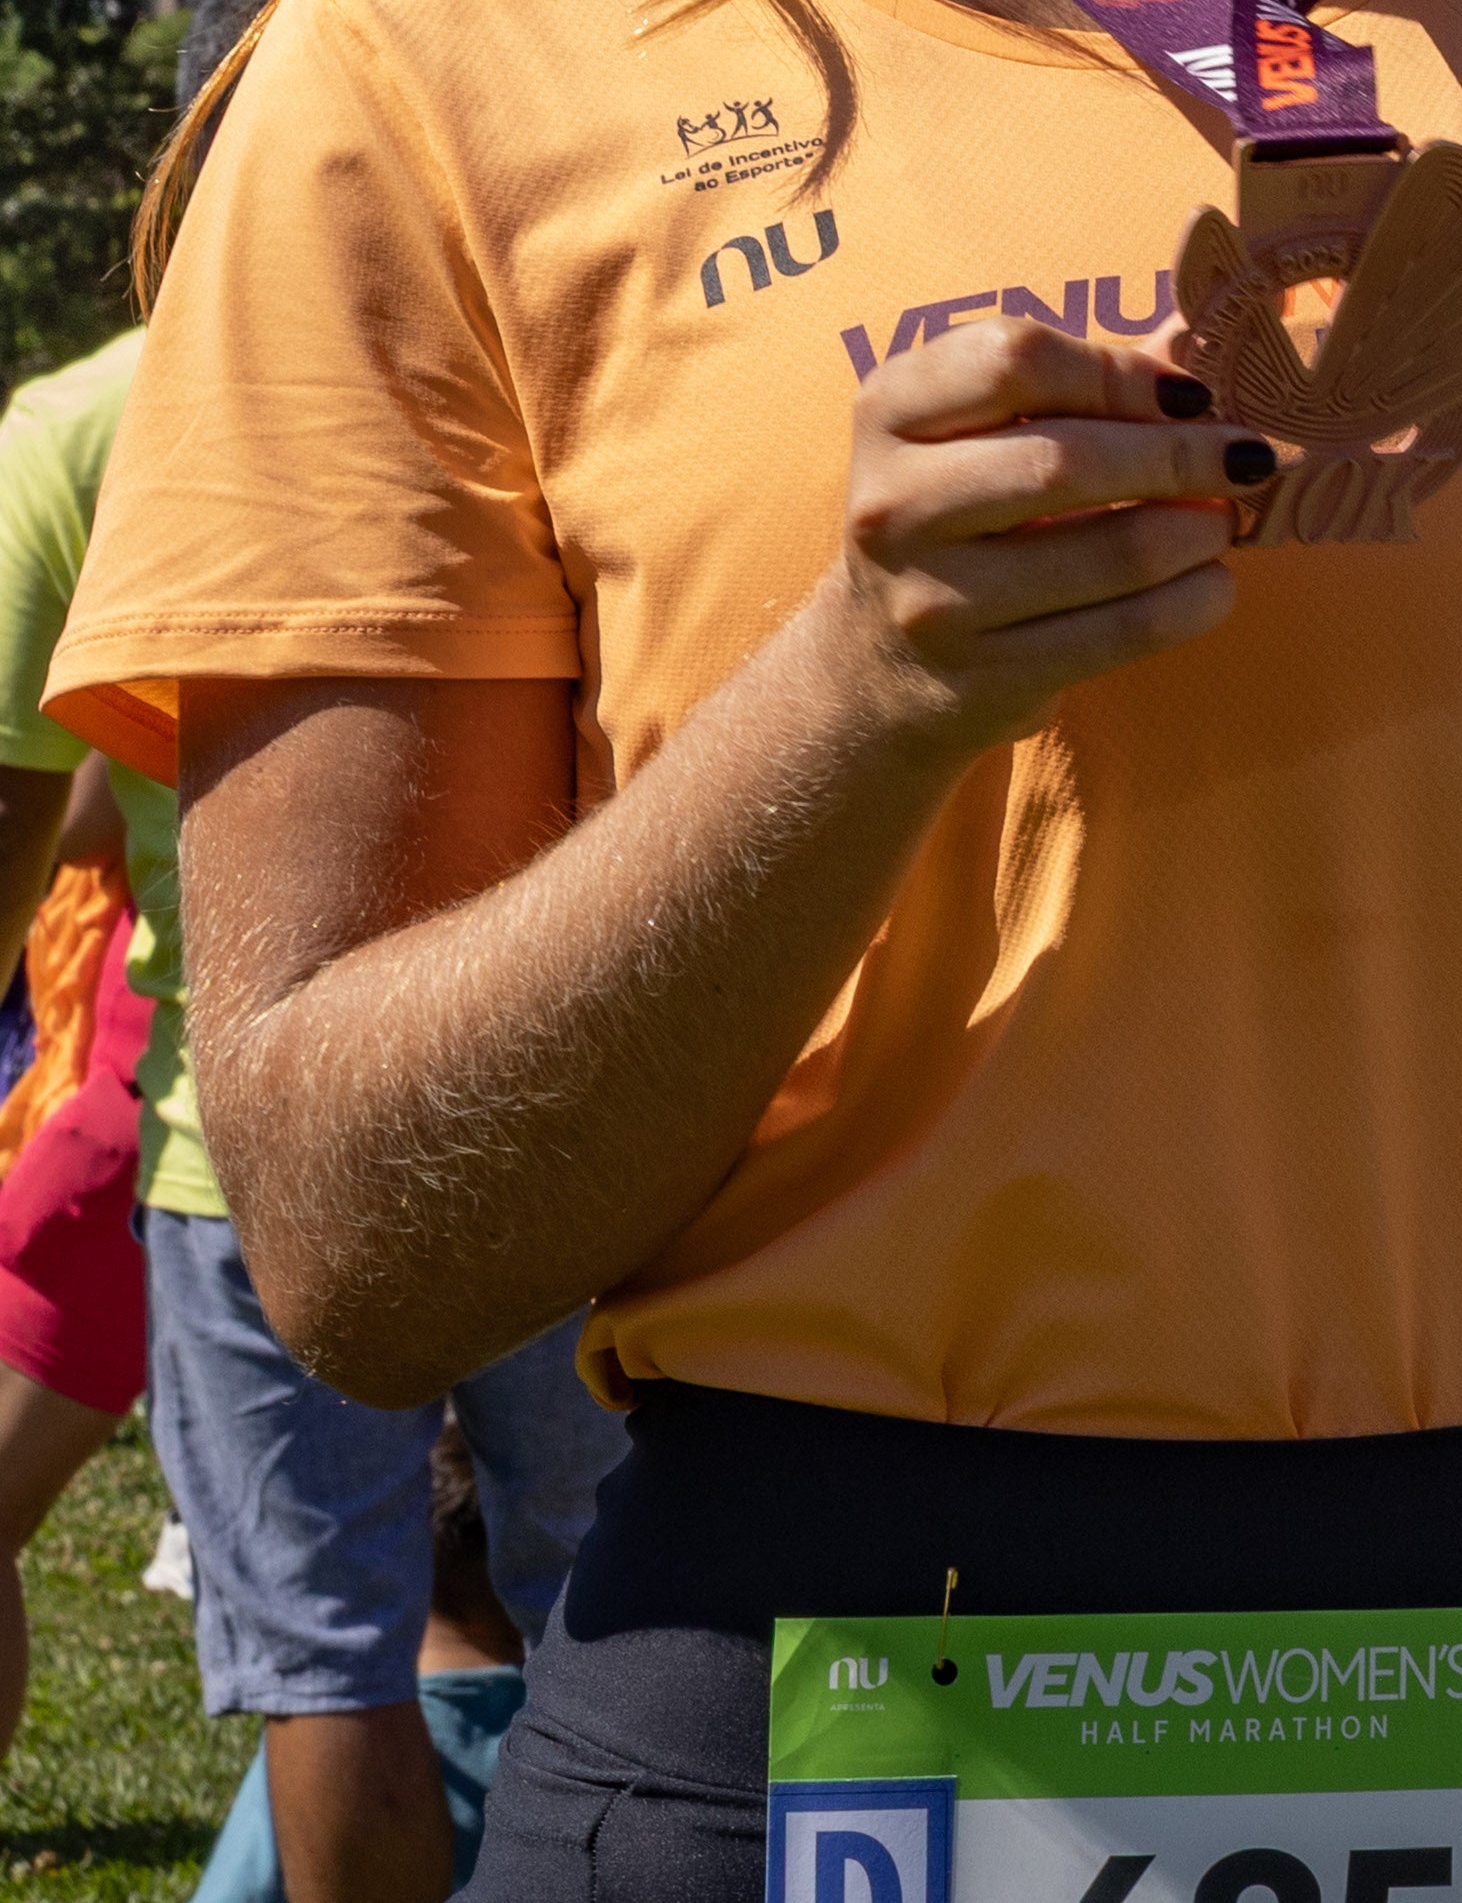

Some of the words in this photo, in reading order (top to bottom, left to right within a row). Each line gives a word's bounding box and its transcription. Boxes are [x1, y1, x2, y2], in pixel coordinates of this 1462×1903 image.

[660, 168, 692, 185] Lei
[698, 160, 723, 175] de
[728, 137, 825, 167] Incentivo
[694, 178, 719, 192] ao
[725, 154, 806, 184] Esporte
[829, 1703, 886, 1712] APRESENTA
[1080, 1720, 1170, 1746] HALF
[1189, 1714, 1389, 1744] MARATHON
